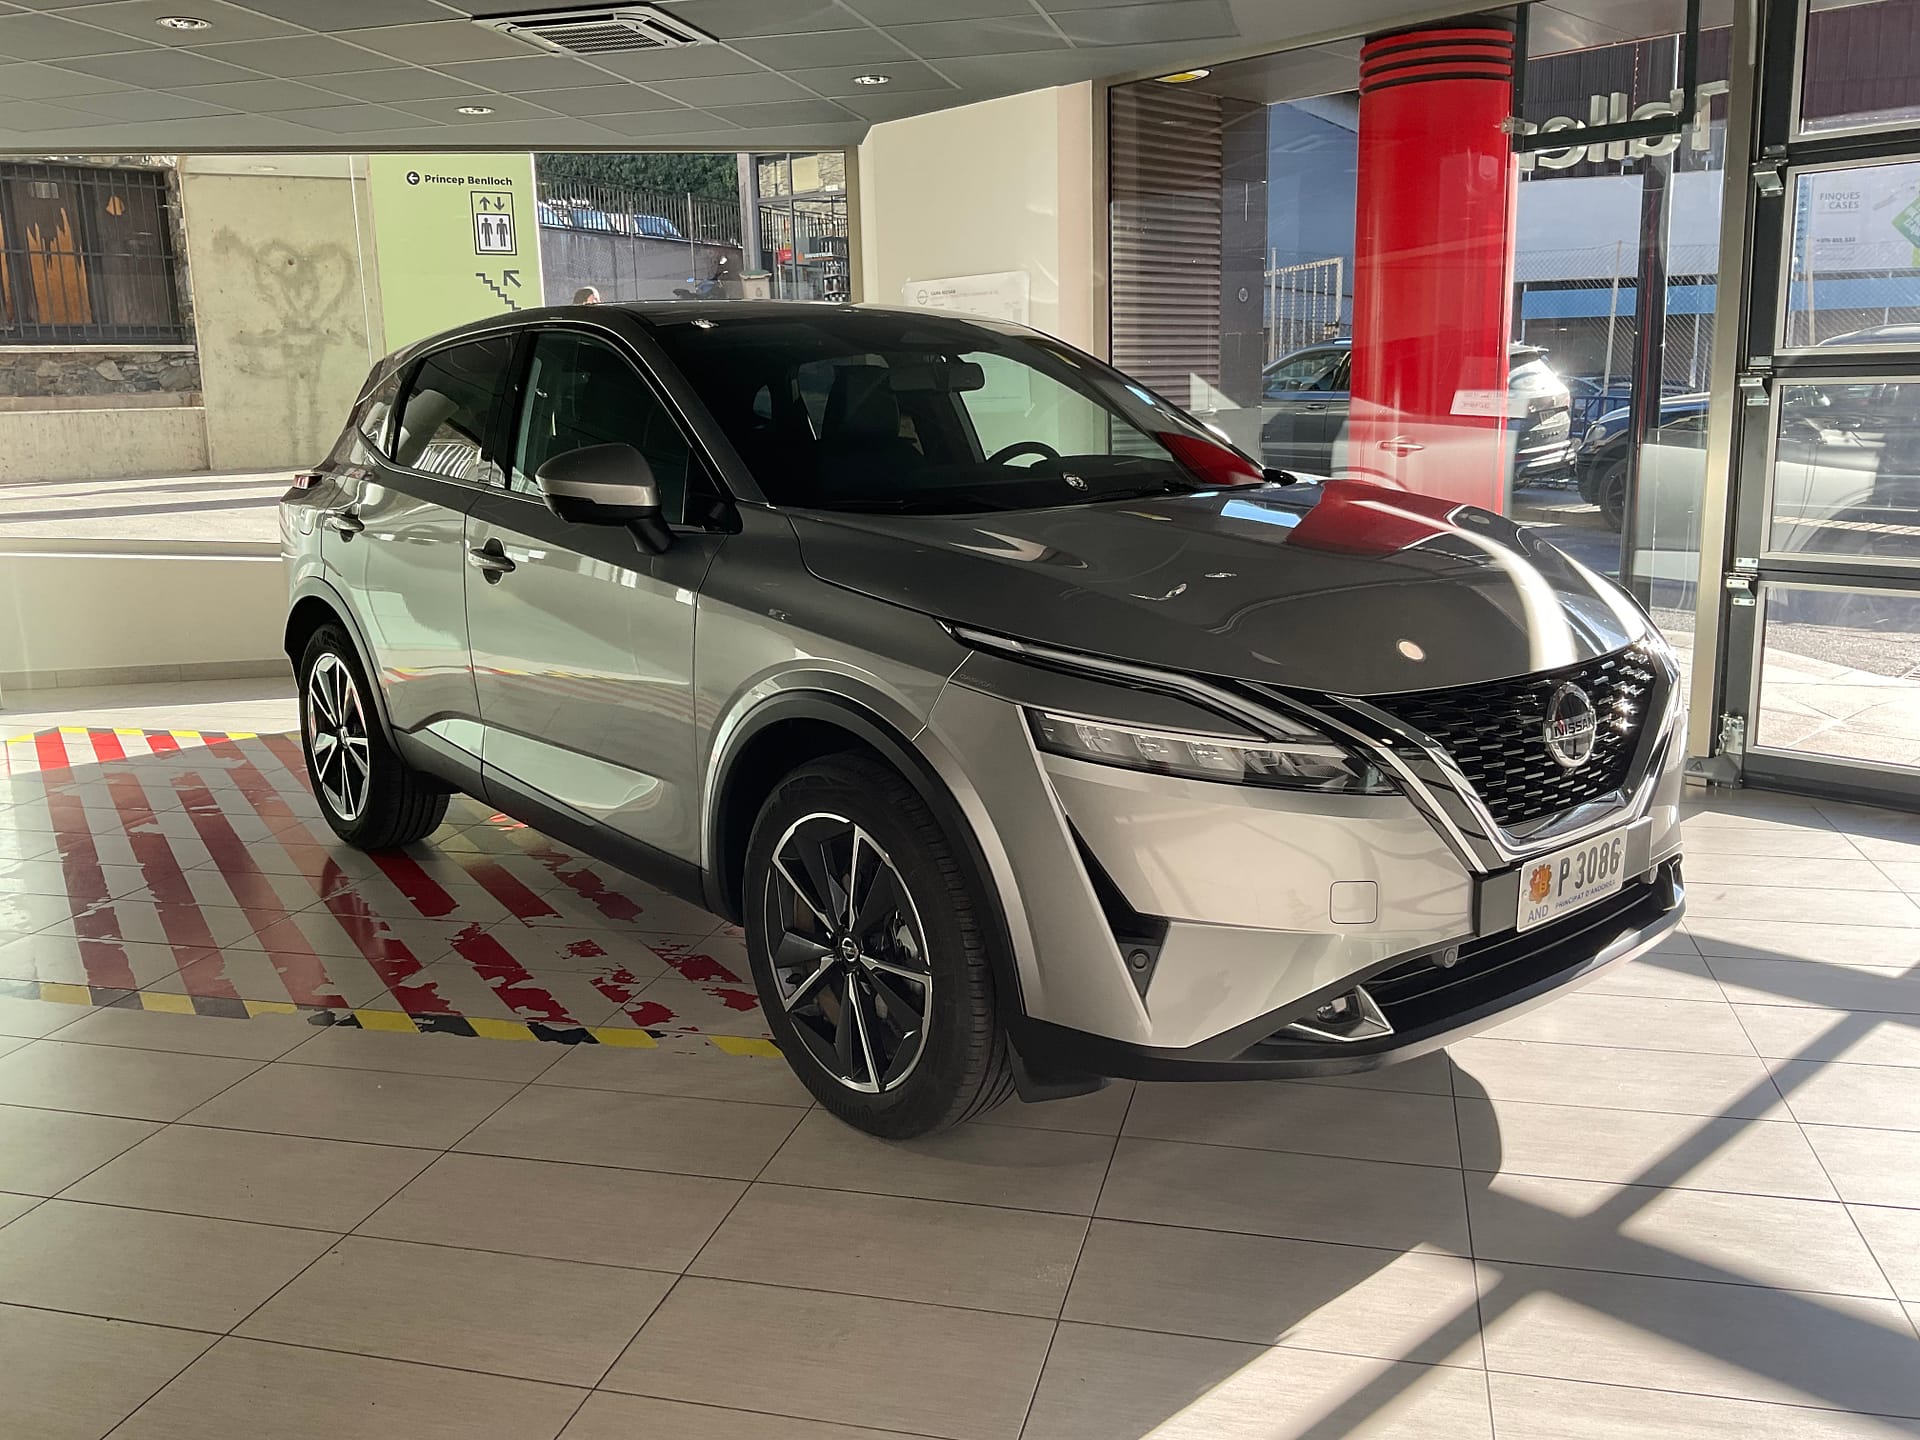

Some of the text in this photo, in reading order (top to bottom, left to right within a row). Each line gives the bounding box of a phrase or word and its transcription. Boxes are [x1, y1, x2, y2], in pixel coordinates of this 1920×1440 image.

[424, 174, 513, 186] Princep Benlloch
[1820, 192, 1860, 201] FINQUES
[1829, 201, 1859, 209] CASES
[1553, 715, 1593, 738] NISSAN
[1557, 837, 1621, 897] P 3086
[1527, 904, 1549, 923] AND
